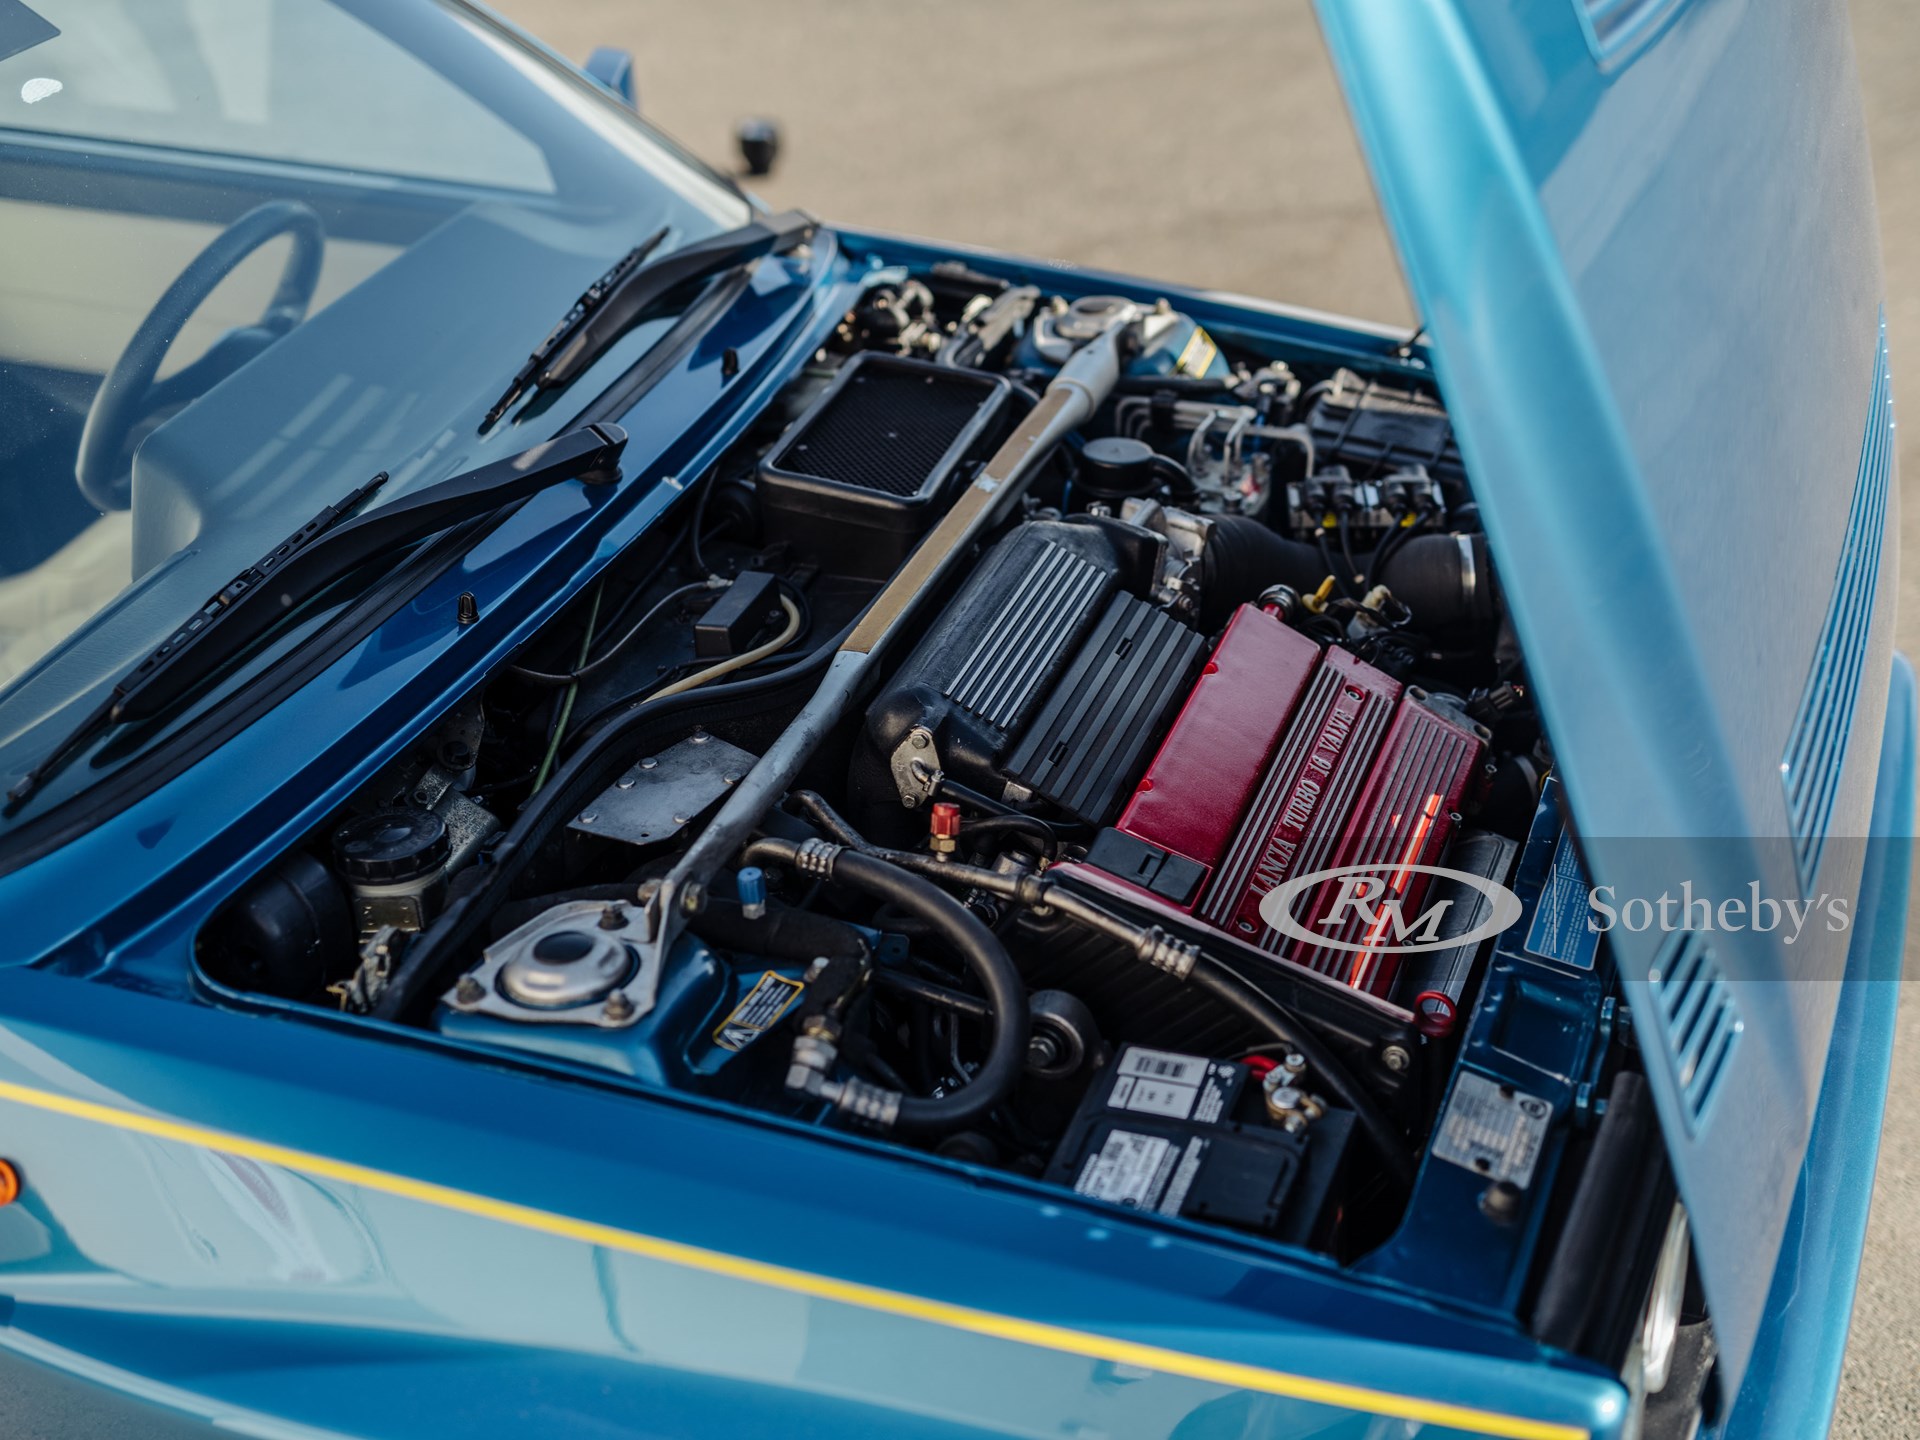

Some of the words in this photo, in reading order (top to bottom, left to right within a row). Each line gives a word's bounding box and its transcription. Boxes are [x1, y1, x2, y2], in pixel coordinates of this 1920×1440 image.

[1319, 708, 1355, 753] VALVE
[1311, 755, 1333, 778] 16
[1282, 779, 1321, 832] TURBO
[1250, 837, 1297, 896] LANCIA
